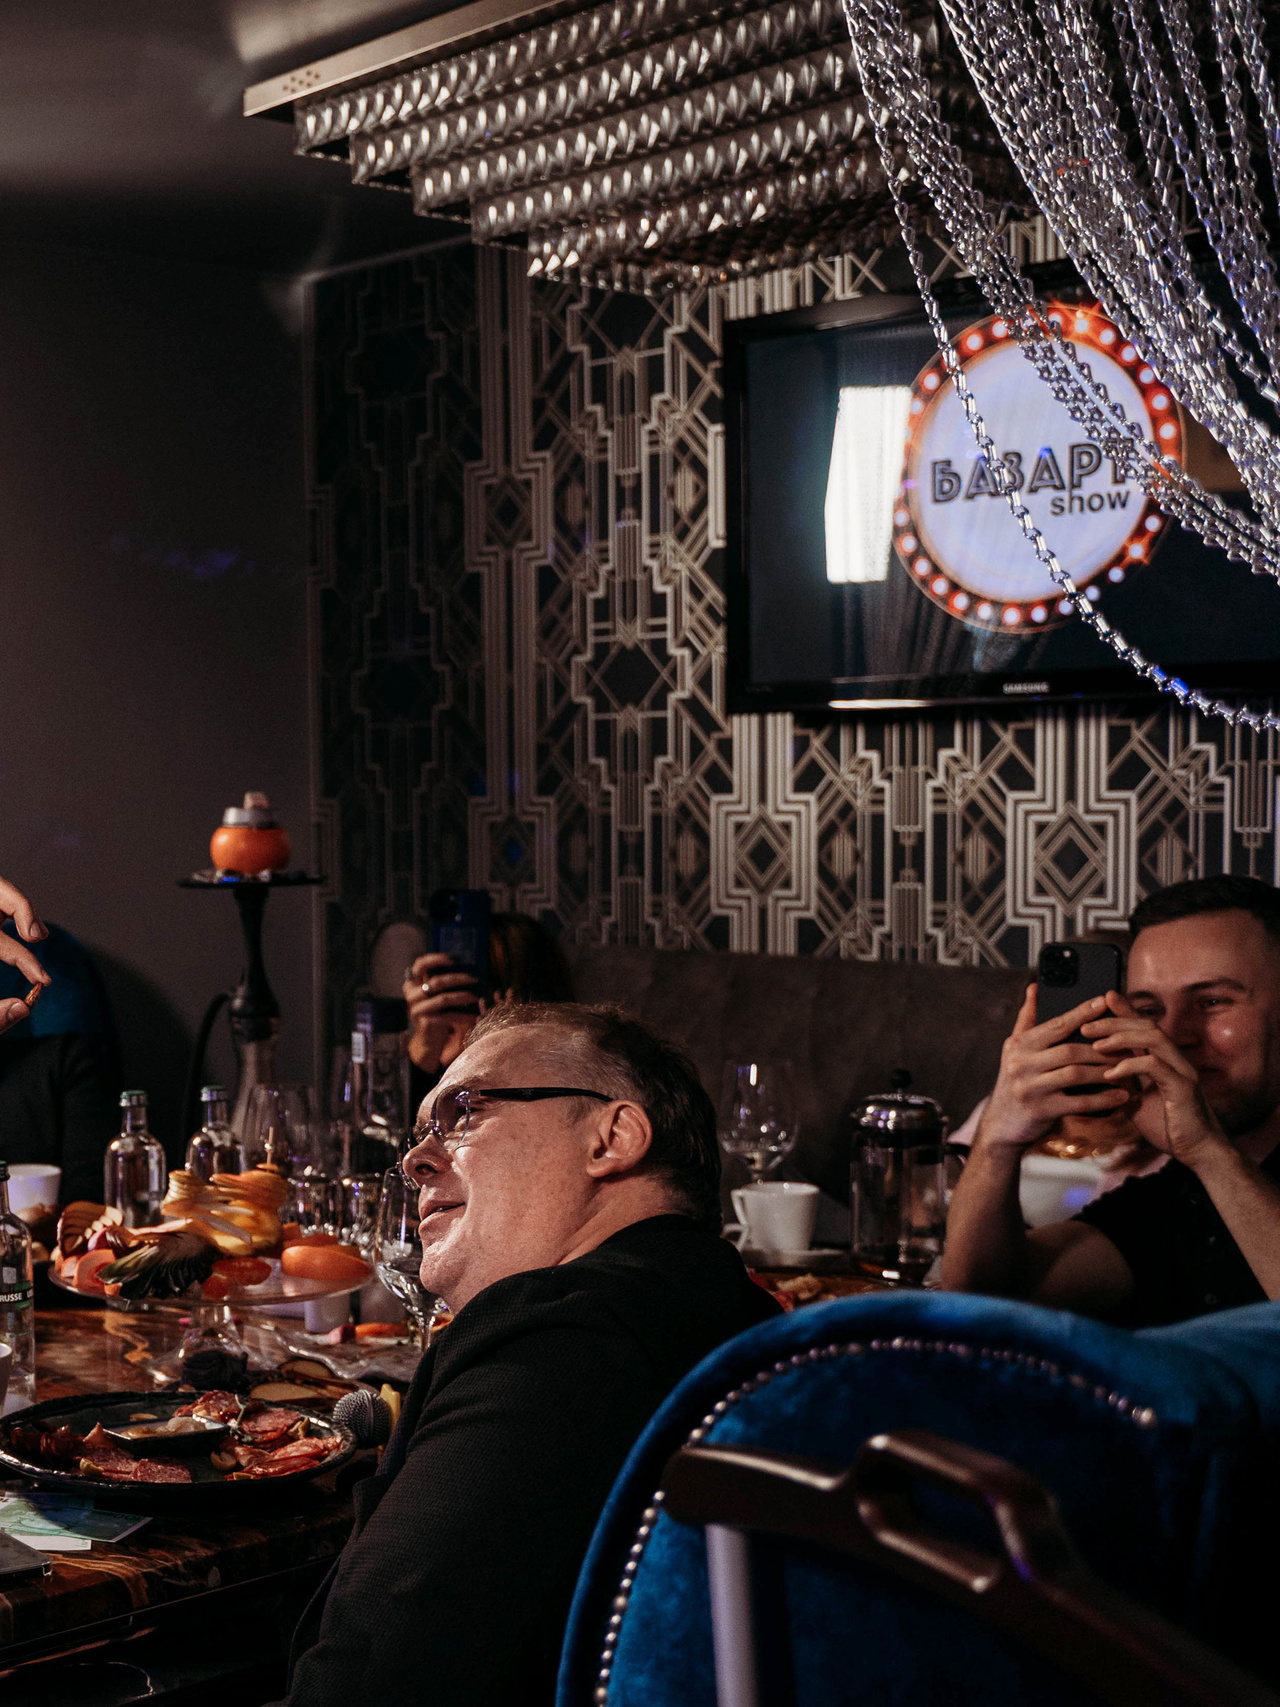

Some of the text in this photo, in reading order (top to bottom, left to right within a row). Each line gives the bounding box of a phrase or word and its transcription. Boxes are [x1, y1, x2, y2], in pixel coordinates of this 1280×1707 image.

[1050, 490, 1130, 517] show
[1002, 681, 1050, 695] SAMSUNG
[0, 1292, 23, 1303] RUSSE
